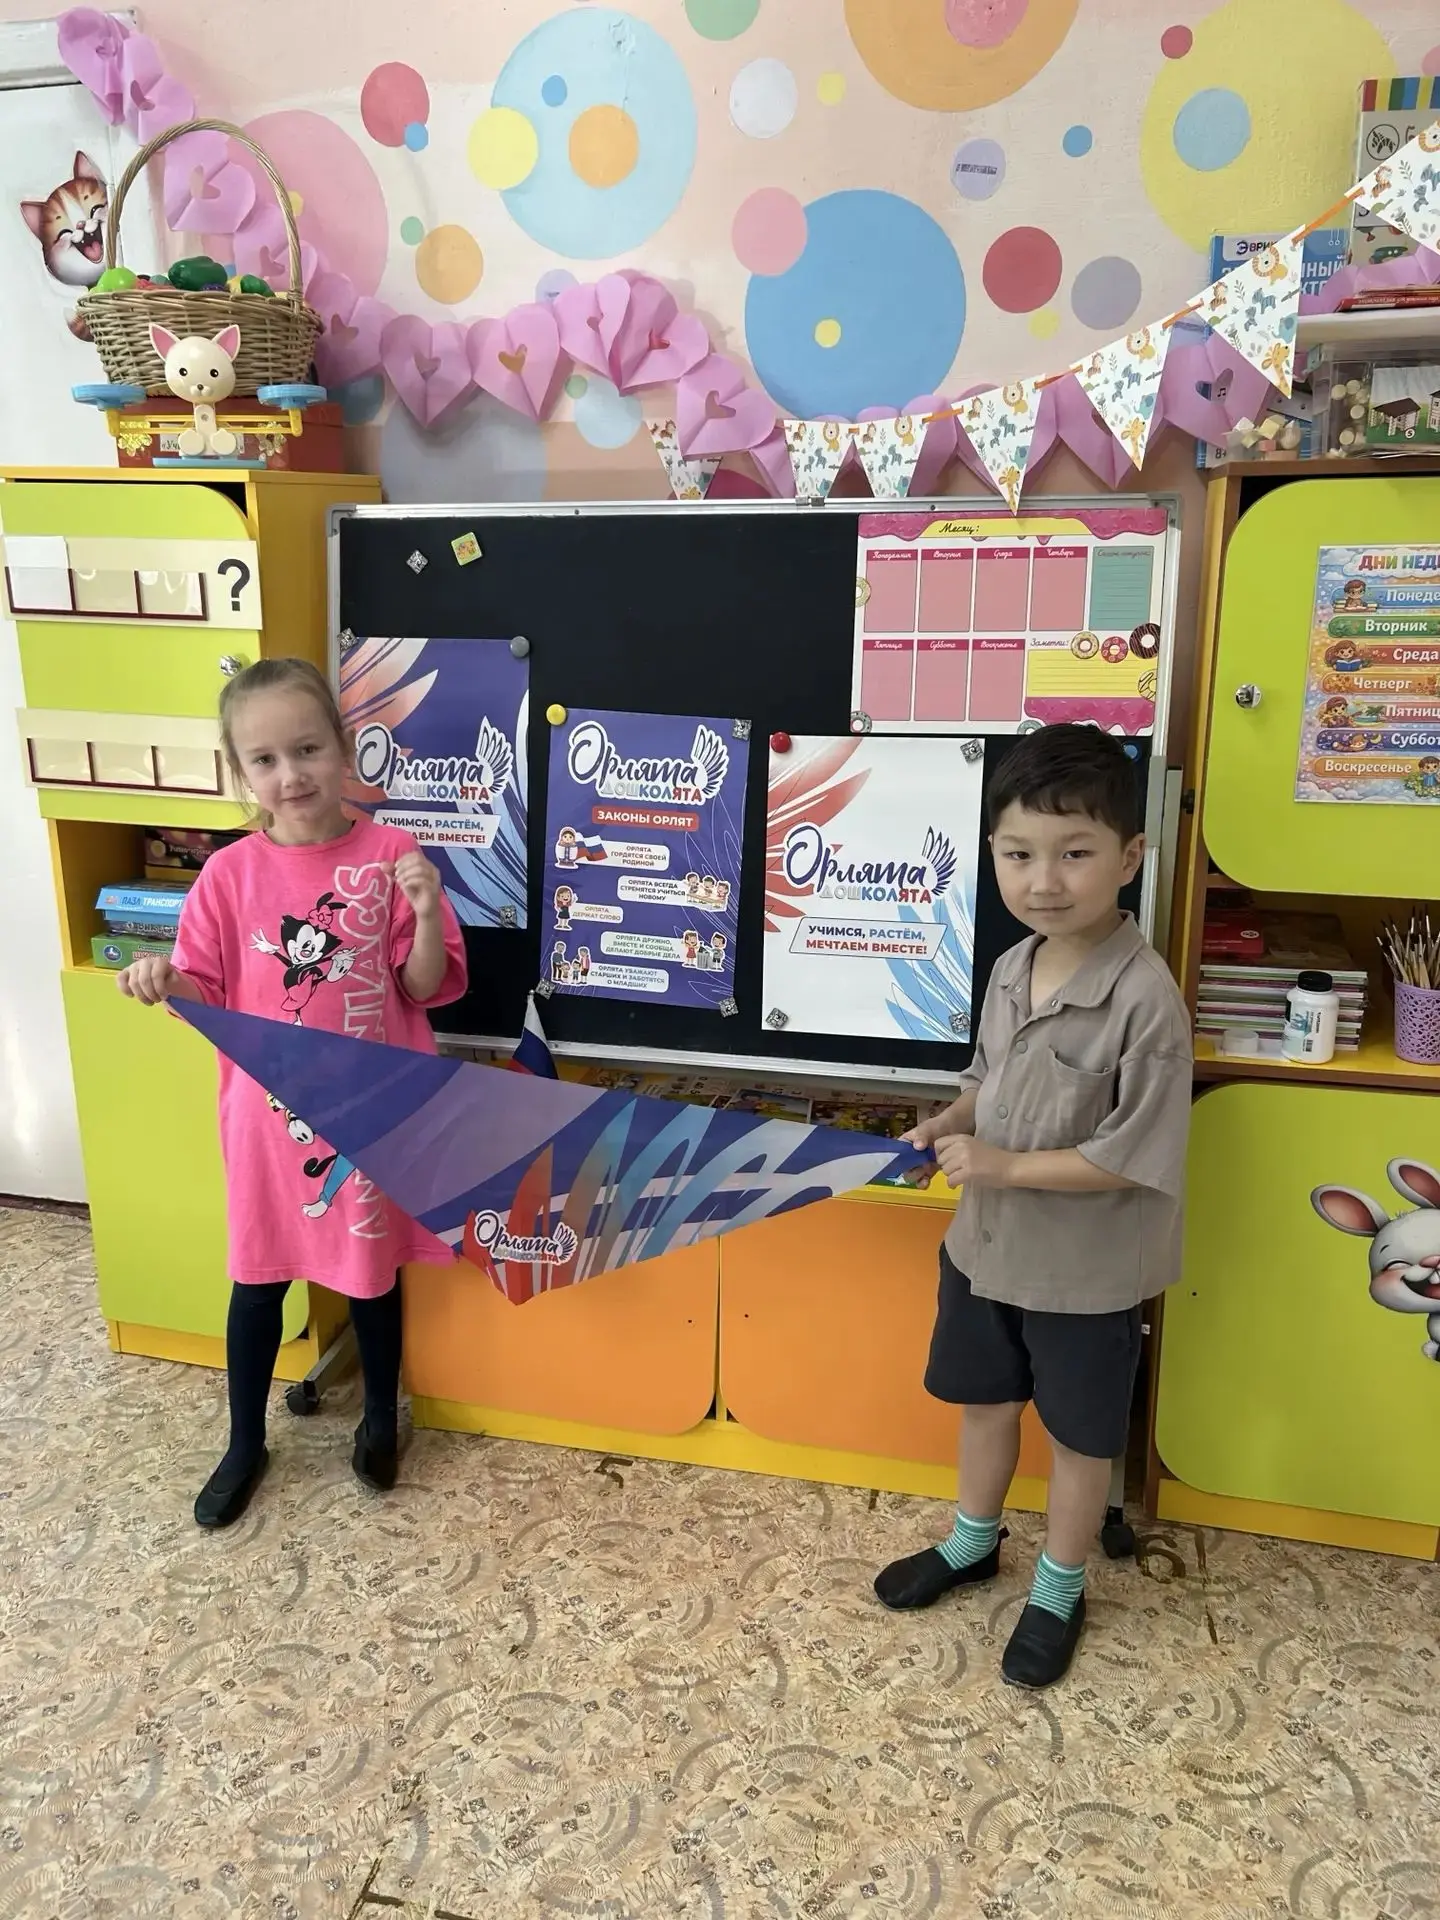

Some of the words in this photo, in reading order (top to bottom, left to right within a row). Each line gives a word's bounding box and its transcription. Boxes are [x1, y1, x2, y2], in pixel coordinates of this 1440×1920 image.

[939, 523, 980, 534] Месяц:
[933, 550, 962, 559] Вторник
[993, 550, 1013, 558] Среда
[1359, 555, 1398, 571] ДНИ
[1365, 620, 1428, 634] Вторник
[930, 640, 956, 650] Суббота
[1393, 648, 1439, 663] Среда
[1353, 677, 1413, 692] Четверг
[357, 725, 485, 791] Орлята
[571, 724, 697, 788] Орлята
[1325, 760, 1412, 775] Воскресенье
[382, 816, 432, 829] УЧИМСЯ,
[435, 819, 484, 831] РАСТЁМ,
[597, 810, 650, 824] ЗАКОНЫ
[652, 814, 694, 827] ОРЛЯТ
[438, 833, 485, 843] ВМЕСТЕ!
[611, 851, 643, 859] ГОРДЯТСЯ
[644, 853, 667, 861] СВОЕЙ
[622, 859, 654, 867] РОДИНОЙ
[786, 825, 926, 892] Орлята
[628, 879, 653, 887] ОРЛЯТА
[639, 893, 666, 901] НОВОМУ
[615, 934, 641, 942] ОРЛЯТА
[808, 925, 866, 939] УЧИМСЯ,
[869, 927, 926, 942] РАСТЁМ,
[806, 939, 868, 952] МЕЧТАЕМ
[872, 943, 928, 955] ВМЕСТЕ!
[476, 1212, 558, 1253] Орлята
